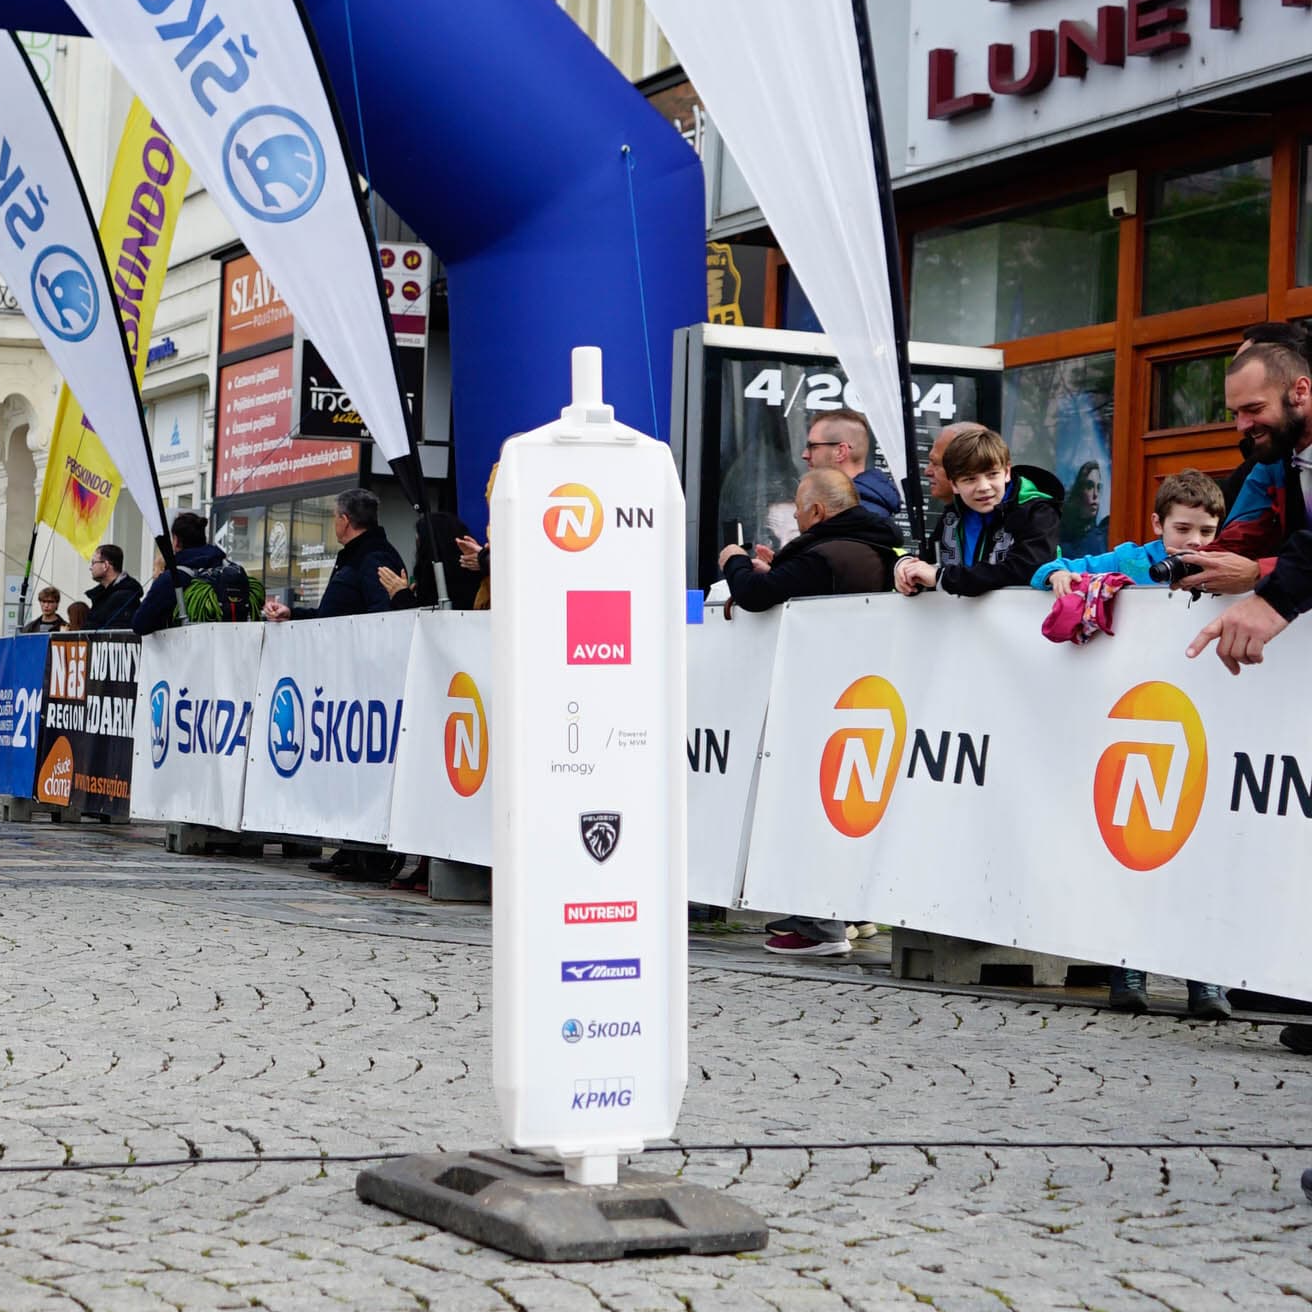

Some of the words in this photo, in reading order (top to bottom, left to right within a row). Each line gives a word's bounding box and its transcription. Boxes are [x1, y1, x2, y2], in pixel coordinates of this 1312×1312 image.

[231, 270, 282, 316] SLAV
[744, 369, 956, 419] 4/24
[616, 507, 654, 529] NN
[573, 644, 625, 659] AVON
[50, 645, 86, 697] Náš
[46, 702, 84, 732] REGION
[551, 761, 595, 775] innogy
[907, 728, 990, 786] NN
[1231, 752, 1312, 819] NN
[568, 905, 635, 920] NUTREND
[587, 1021, 641, 1038] ŠKODA
[572, 1090, 632, 1109] KPMG
